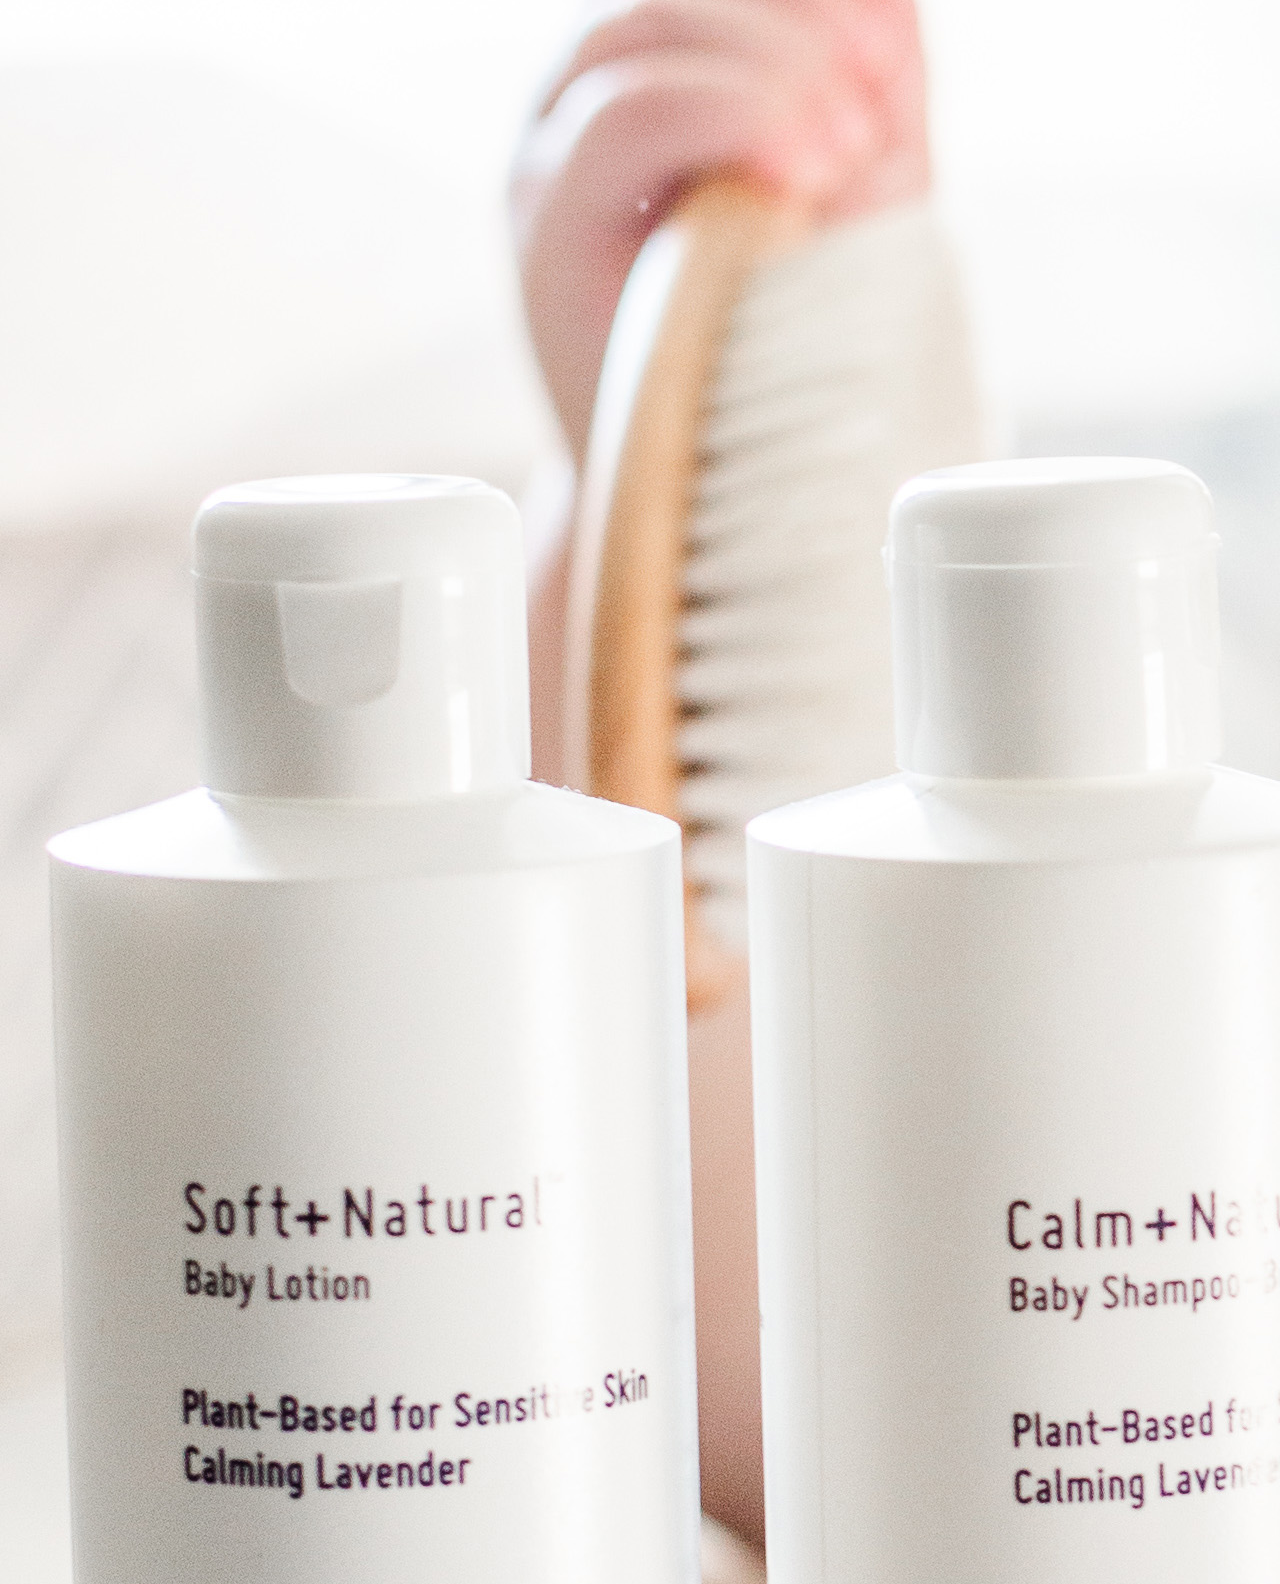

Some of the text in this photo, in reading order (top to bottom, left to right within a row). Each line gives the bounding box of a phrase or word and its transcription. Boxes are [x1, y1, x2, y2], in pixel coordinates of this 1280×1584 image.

[183, 1175, 543, 1239] Soft+Natural
[184, 1259, 371, 1309] Baby Lotion
[1009, 1276, 1089, 1321] Baby
[1102, 1273, 1240, 1313] Shampoo
[182, 1368, 649, 1433] Plant-Based for Sensite Skin
[1012, 1400, 1214, 1449] Plant-Based
[182, 1444, 472, 1499] Calming Lavender
[1015, 1466, 1145, 1510] Calming
